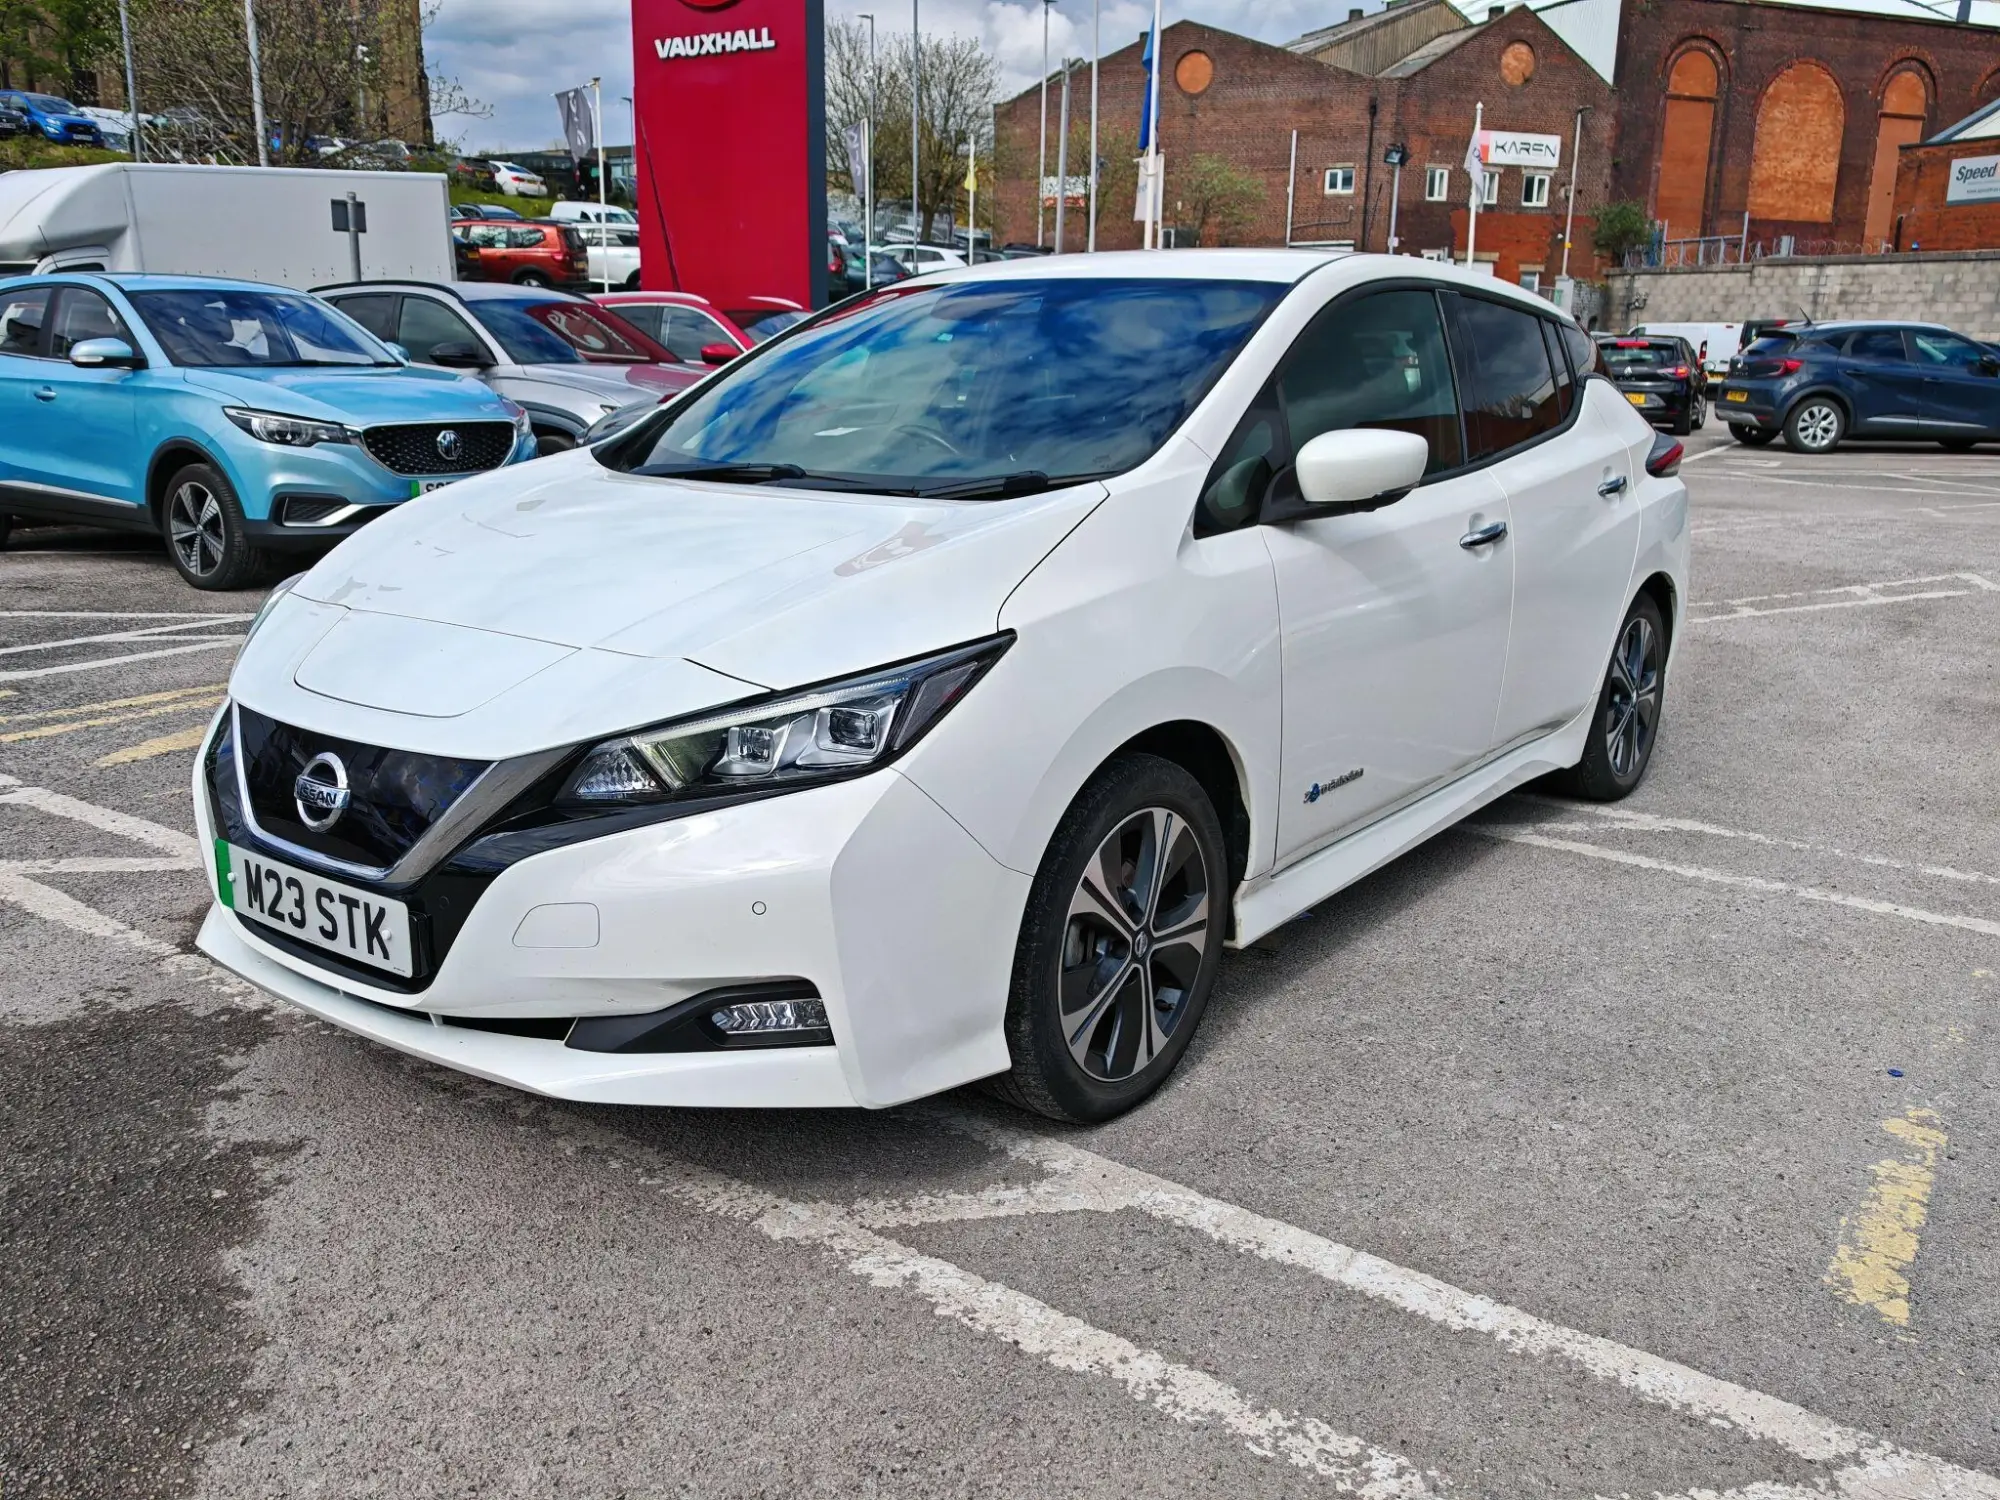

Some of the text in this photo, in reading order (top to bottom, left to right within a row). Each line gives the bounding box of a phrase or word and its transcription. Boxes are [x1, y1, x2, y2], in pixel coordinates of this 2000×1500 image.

[654, 27, 775, 59] VAUXHALL
[1494, 140, 1557, 158] KAREN
[1956, 162, 1998, 184] Speed
[244, 859, 390, 961] M23 STK
